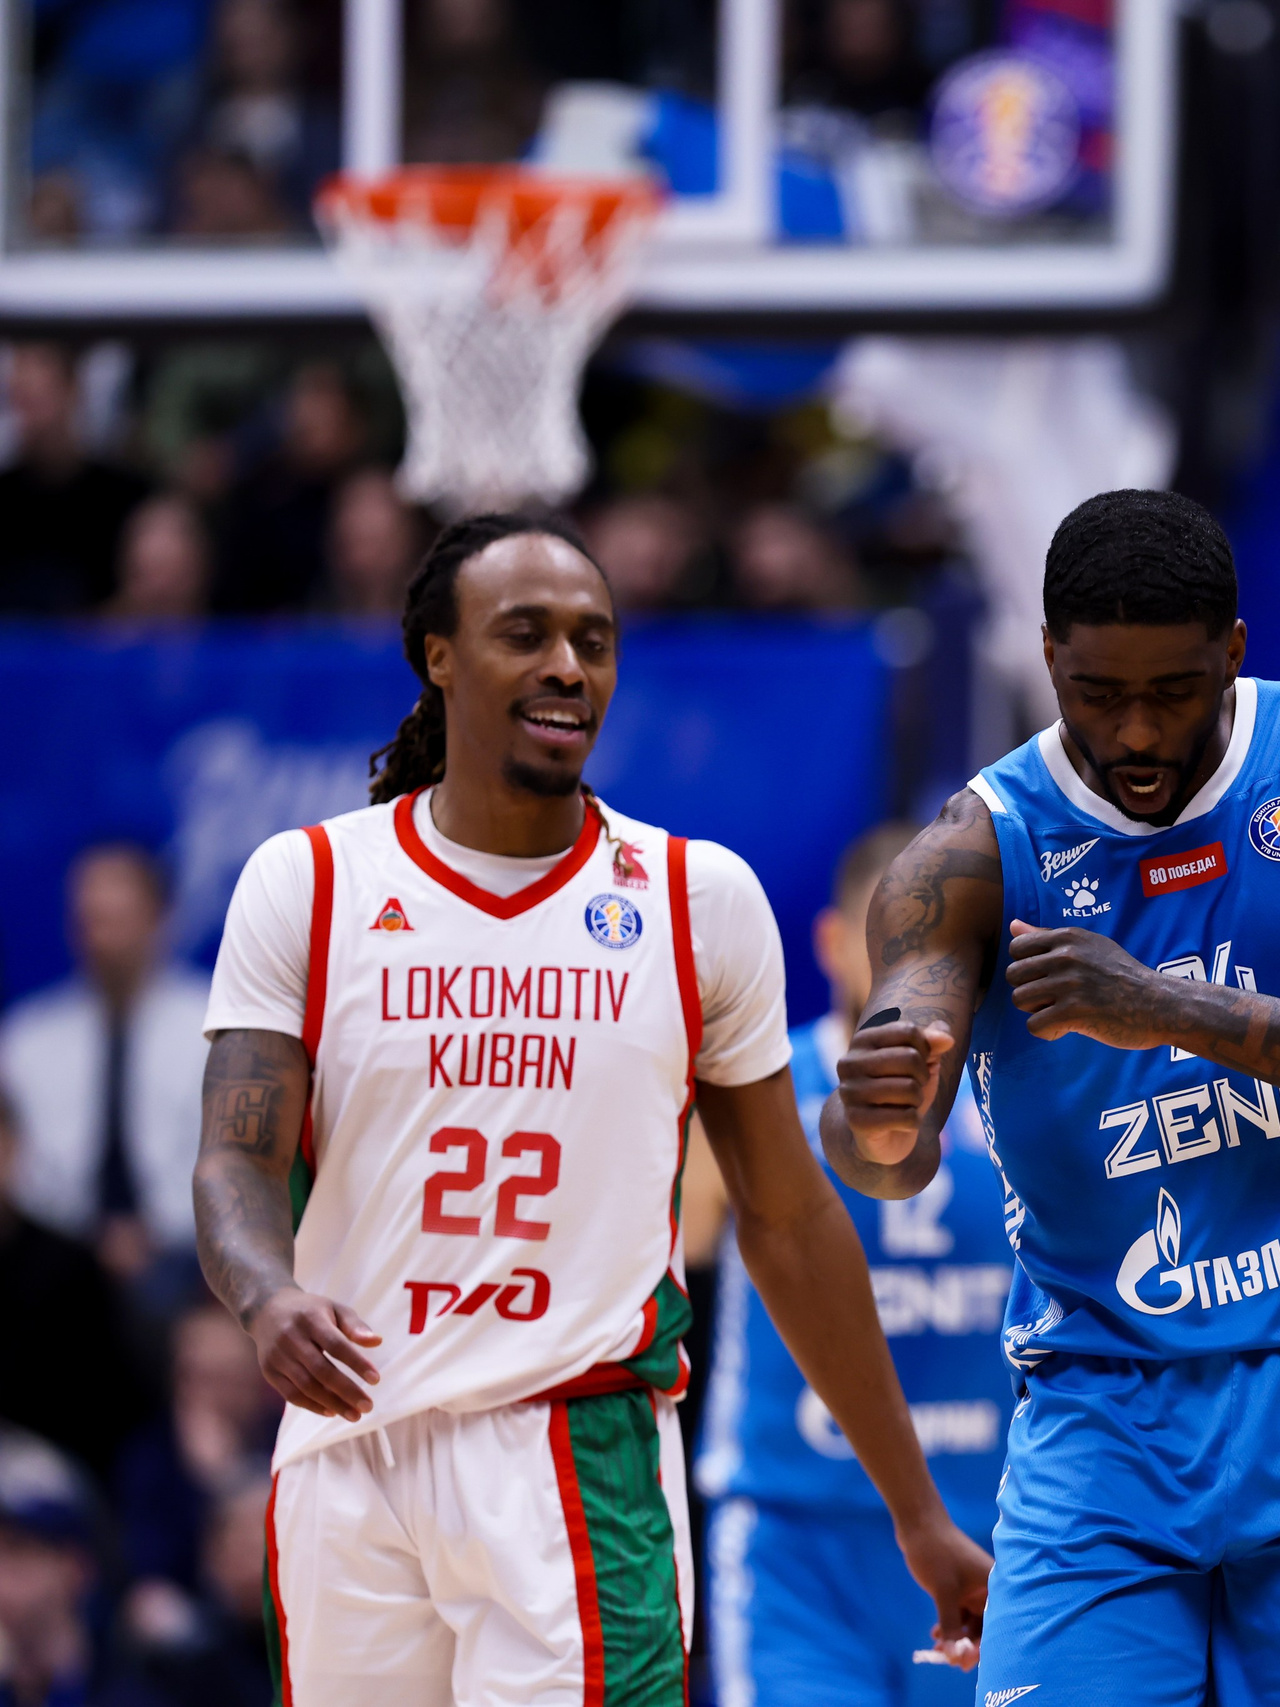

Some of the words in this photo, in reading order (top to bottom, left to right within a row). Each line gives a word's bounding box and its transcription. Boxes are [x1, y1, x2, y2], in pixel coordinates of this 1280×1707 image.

[1254, 802, 1275, 822] ЕДИНАЯ
[1261, 845, 1271, 853] VTB
[1149, 867, 1168, 885] 80
[1168, 854, 1217, 879] ПОБЕДА!
[1062, 901, 1112, 917] KELME
[382, 966, 629, 1022] LOKOMOTIV
[429, 1033, 576, 1090] KUBAN
[421, 1127, 561, 1240] 22
